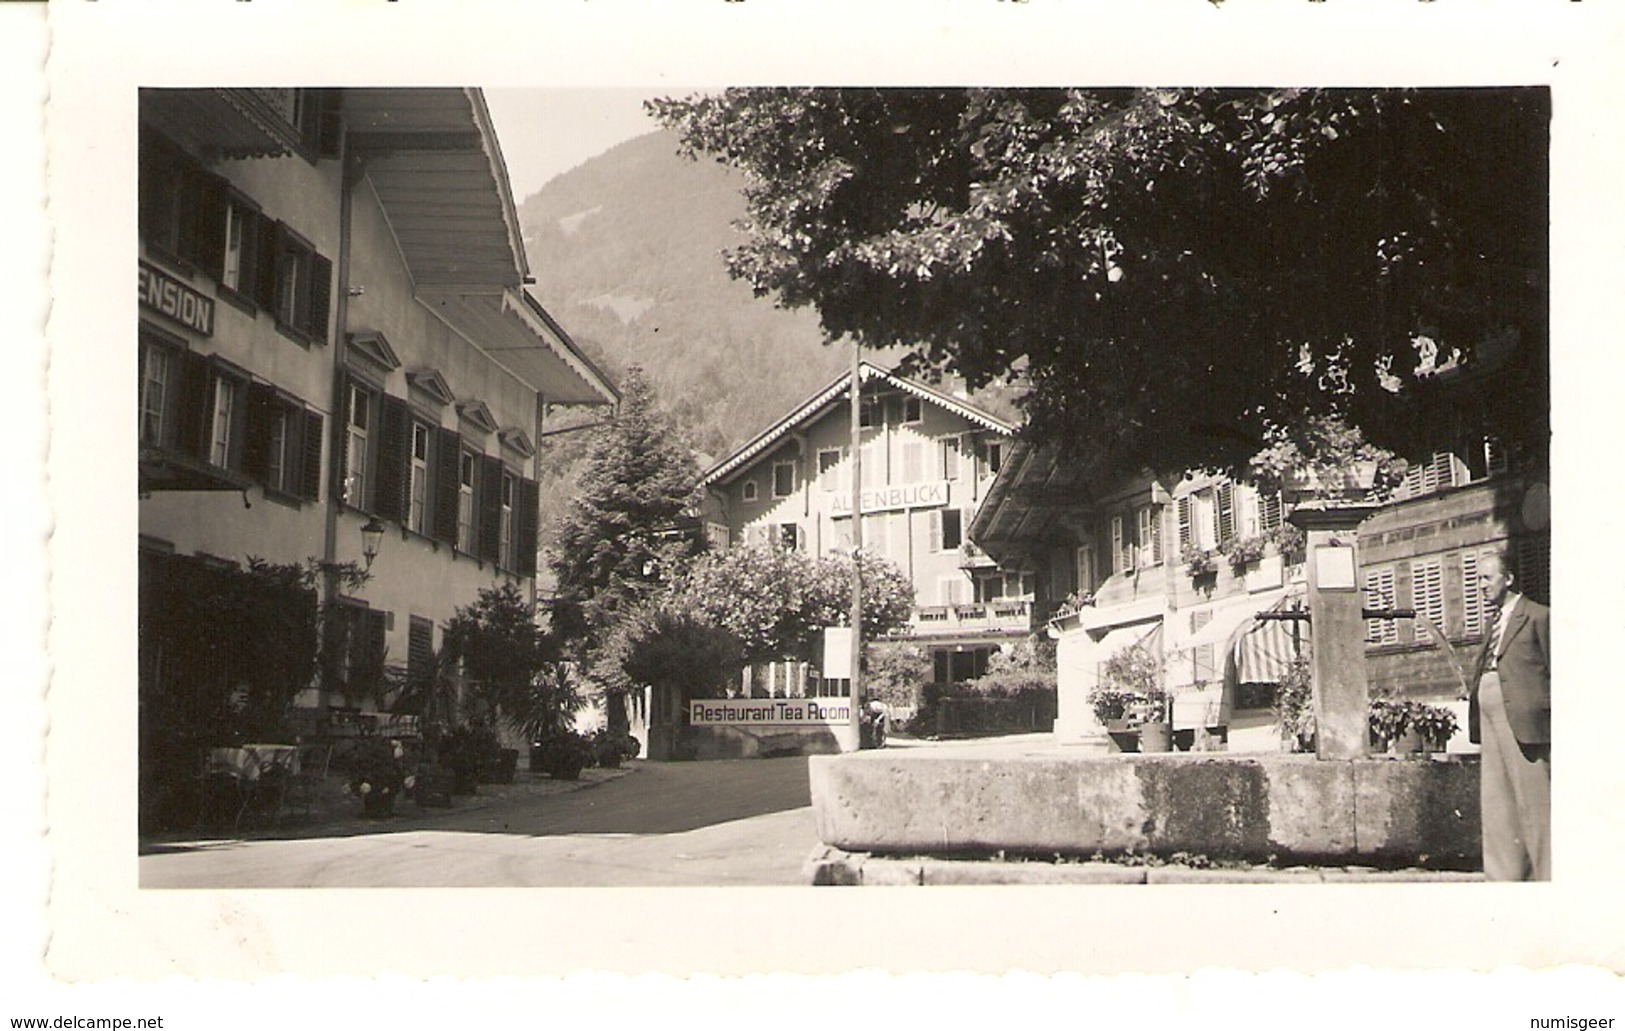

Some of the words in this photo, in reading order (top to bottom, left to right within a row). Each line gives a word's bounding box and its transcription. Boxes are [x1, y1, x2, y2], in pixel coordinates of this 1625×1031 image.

[831, 485, 942, 512] ALENBLICK
[693, 704, 775, 721] Restaurant
[776, 703, 803, 720] Tea
[808, 703, 850, 720] Room
